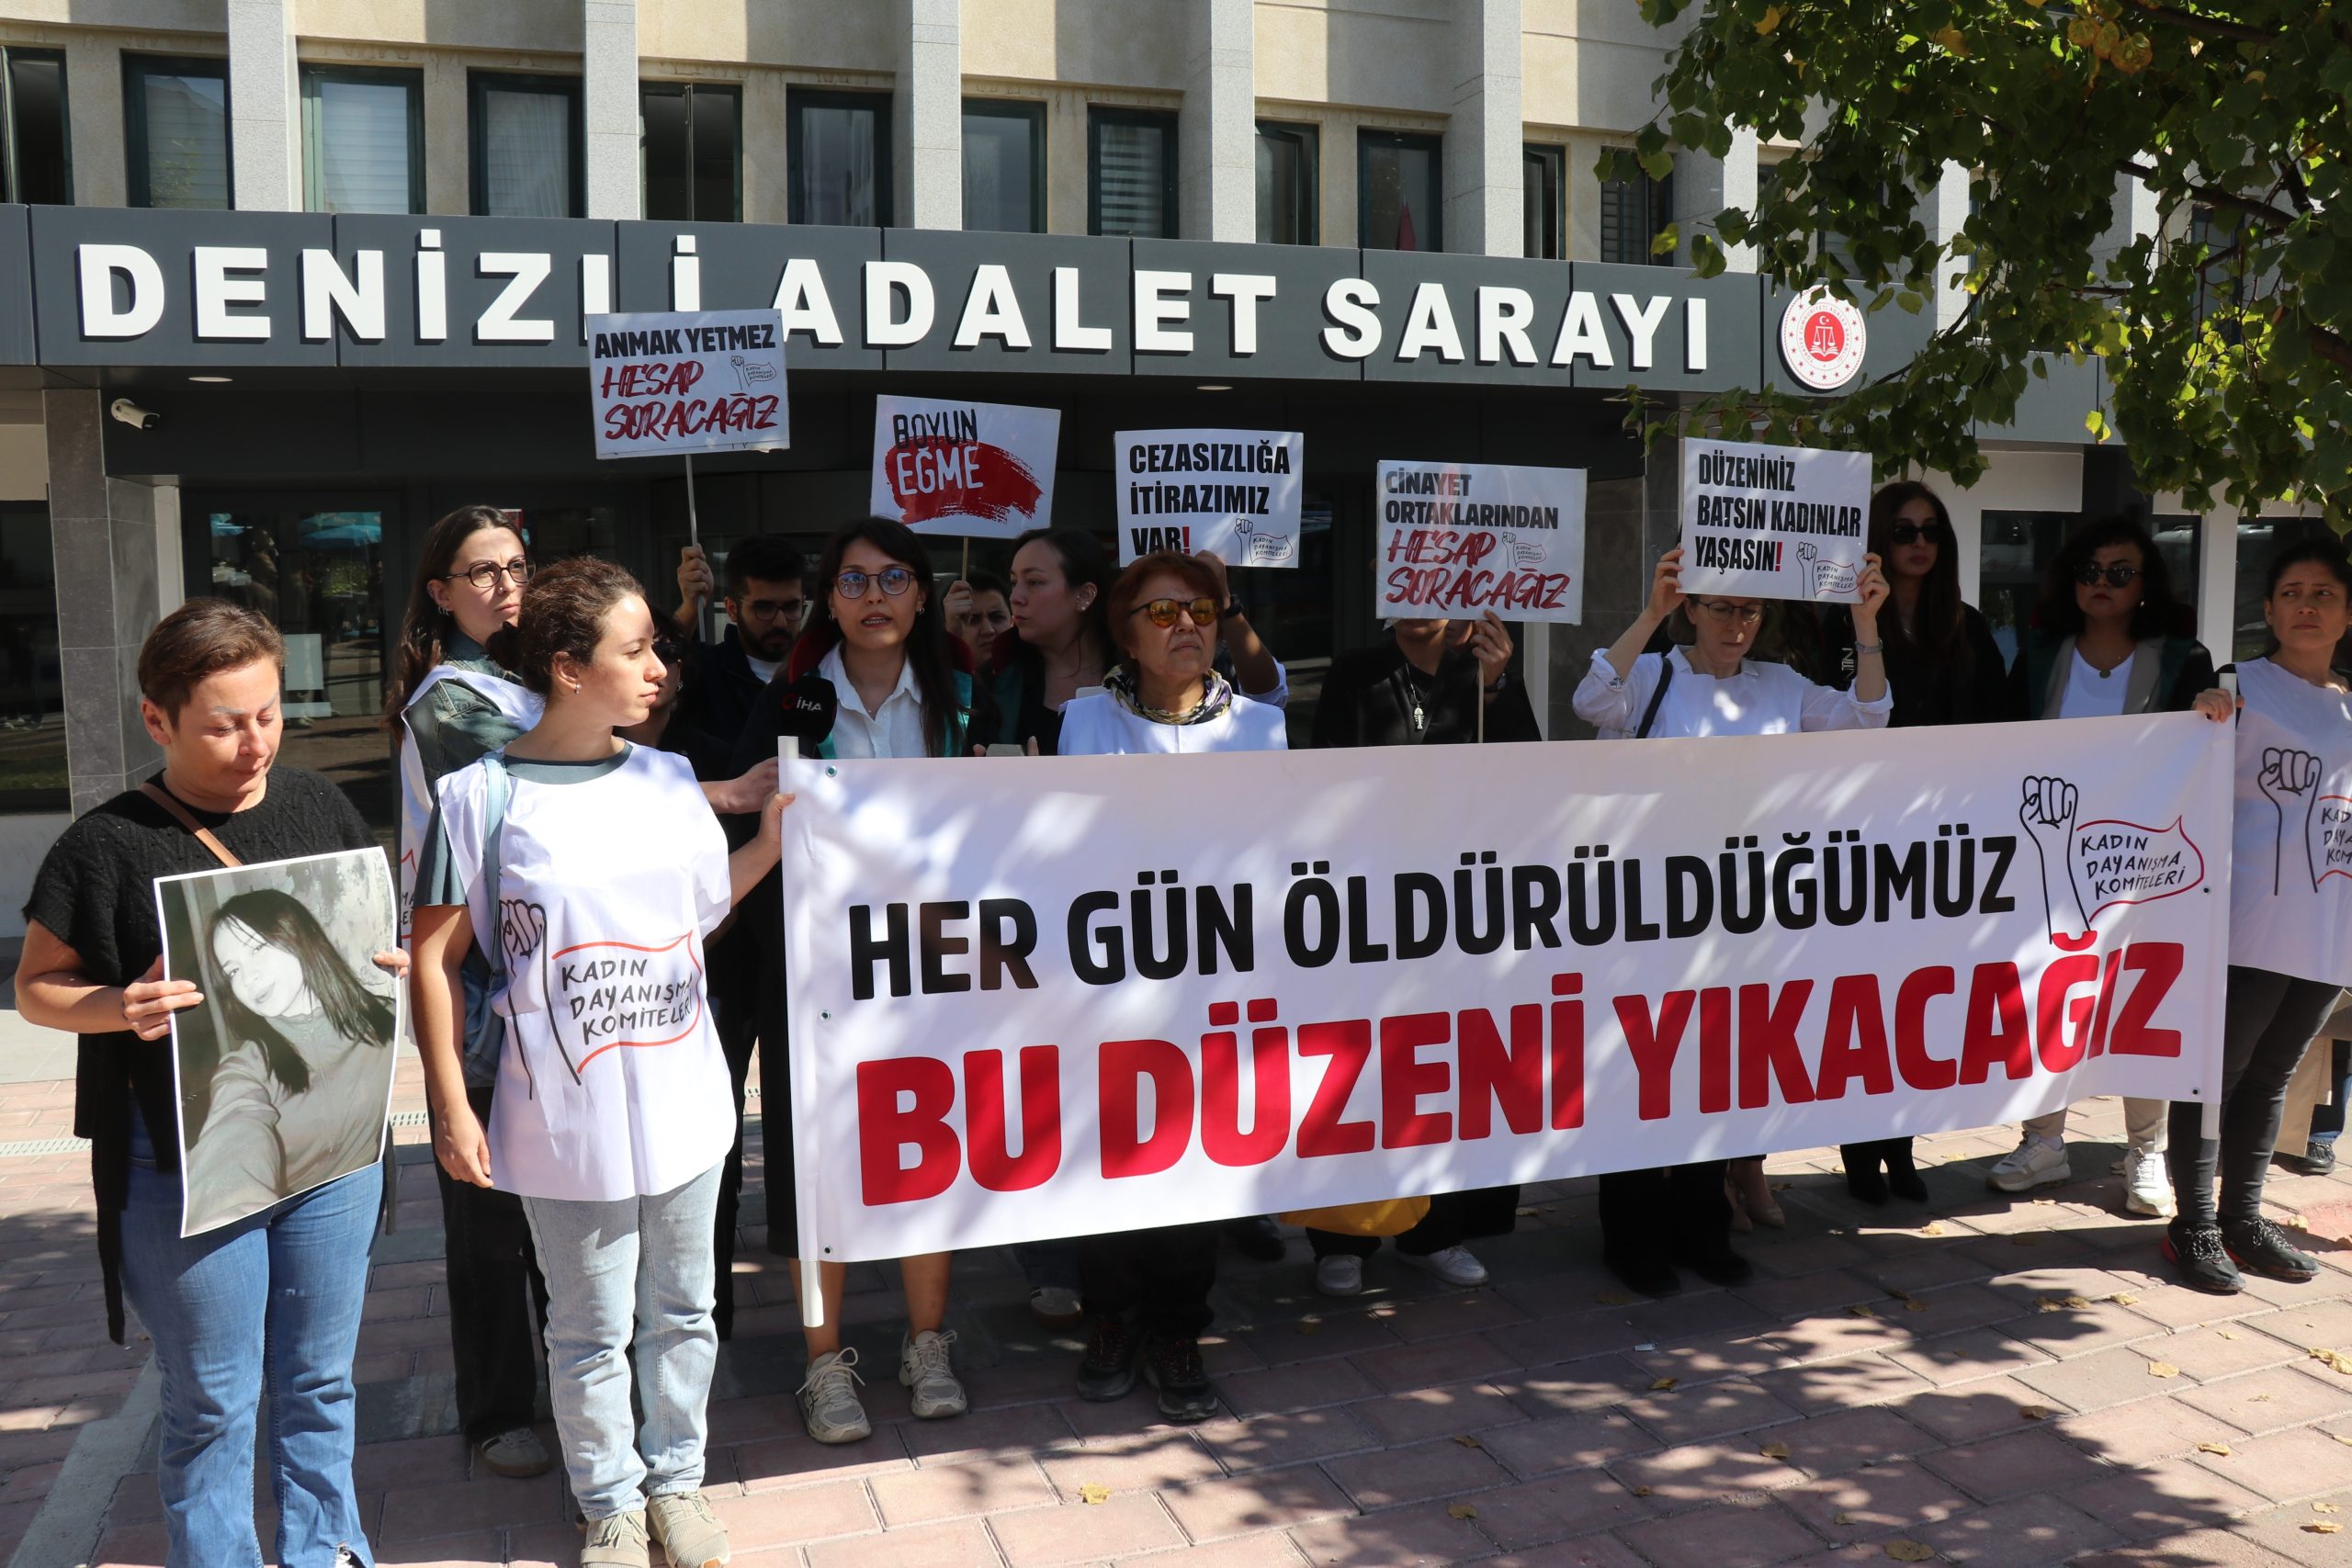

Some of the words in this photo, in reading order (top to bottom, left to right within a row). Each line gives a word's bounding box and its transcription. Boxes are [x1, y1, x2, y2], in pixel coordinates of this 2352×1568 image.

[774, 258, 1276, 354] ADALET
[1324, 277, 1707, 370] SARAYI
[594, 329, 683, 359] ANMAK
[684, 324, 775, 353] YETMEZ
[600, 360, 704, 399] HESAP
[605, 392, 779, 442] SORACAĞIZ
[892, 409, 978, 449] BOYUN
[896, 446, 984, 496] EĞME
[1129, 439, 1291, 474] CEZASIZLIĞA
[1698, 449, 1795, 491] DÜZENİNİZ
[1130, 480, 1270, 515] İTİRAZIMIZ
[1385, 467, 1472, 496] CİNAYET
[1385, 500, 1558, 530] ORTAKLARINDAN
[1697, 494, 1767, 530] BATSIN
[1770, 501, 1861, 537] KADINLAR
[1131, 525, 1190, 556] VAR!
[1387, 528, 1497, 569] HESAP
[1695, 536, 1783, 574] YAŞASIN!
[1385, 567, 1570, 612] SORACAĞIZ
[796, 696, 822, 711] İHA
[2081, 834, 2149, 857] KADIN
[2086, 851, 2181, 879] DAYANIŞMA
[2095, 865, 2186, 901] KOMİTELERİ
[848, 897, 1040, 1000] HER
[1067, 869, 1255, 986] GÜN
[1283, 822, 2017, 968] ÖLDÜRÜLDÜĞÜMÜZ
[561, 959, 648, 991] KADIN
[570, 972, 693, 1020] DAYANIŞMA
[856, 1043, 1062, 1207] BU
[1098, 973, 1584, 1180] DÜZENİ
[1611, 930, 2185, 1121] YIKACAĞIZ
